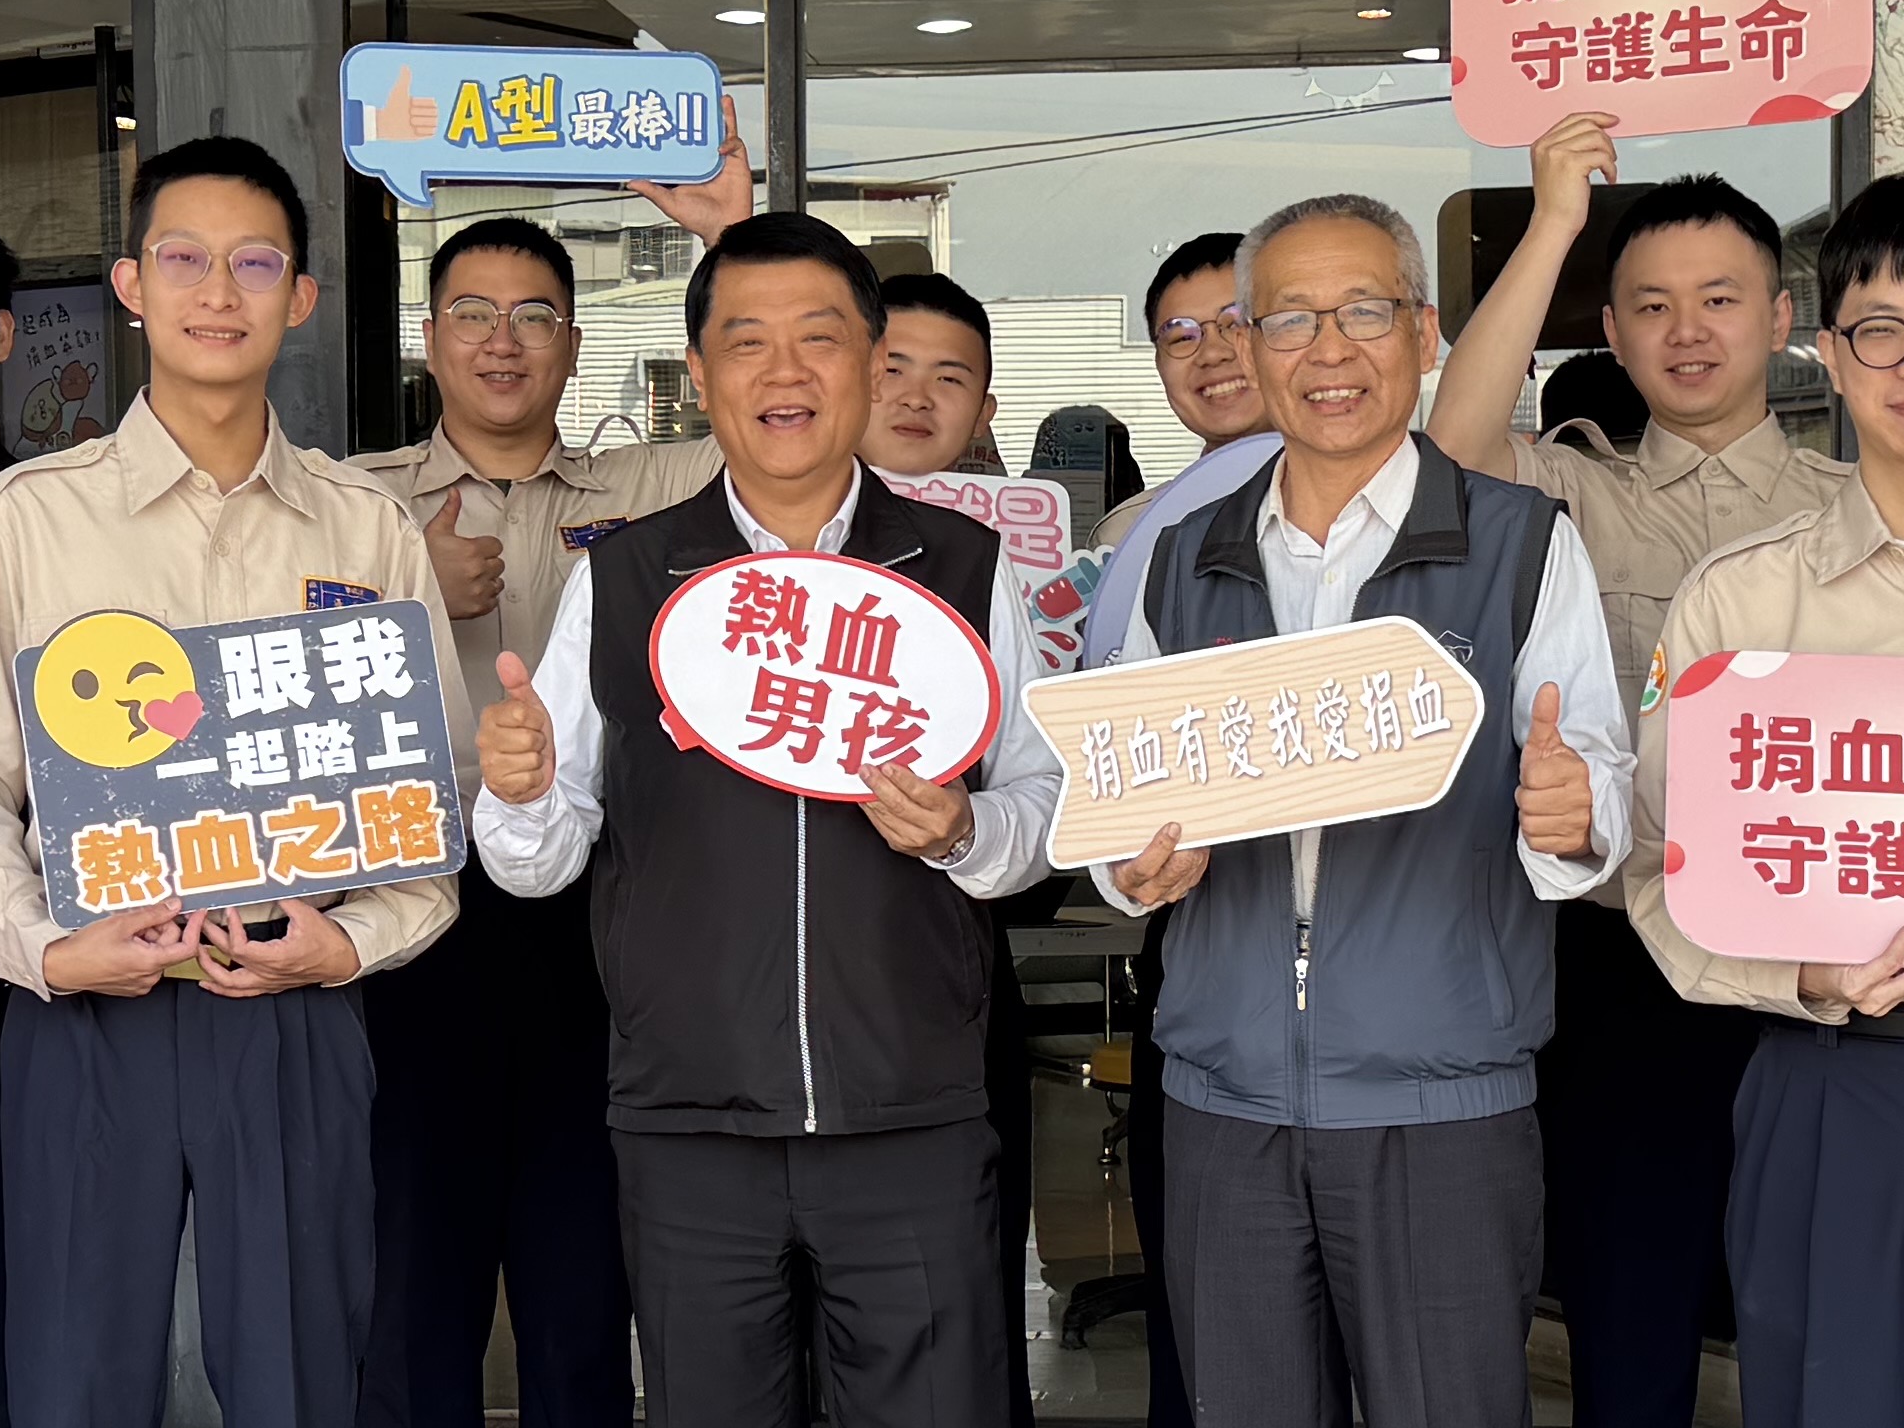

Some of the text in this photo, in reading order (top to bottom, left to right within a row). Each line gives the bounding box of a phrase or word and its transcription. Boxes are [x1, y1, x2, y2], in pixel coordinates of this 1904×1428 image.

[217, 617, 415, 720] 跟我
[722, 568, 903, 688] 熱血
[155, 710, 428, 790] 一起踏上
[738, 666, 931, 775] 男孩
[1079, 666, 1452, 802] 捐血有愛我愛捐血
[71, 779, 447, 913] 熱血之路
